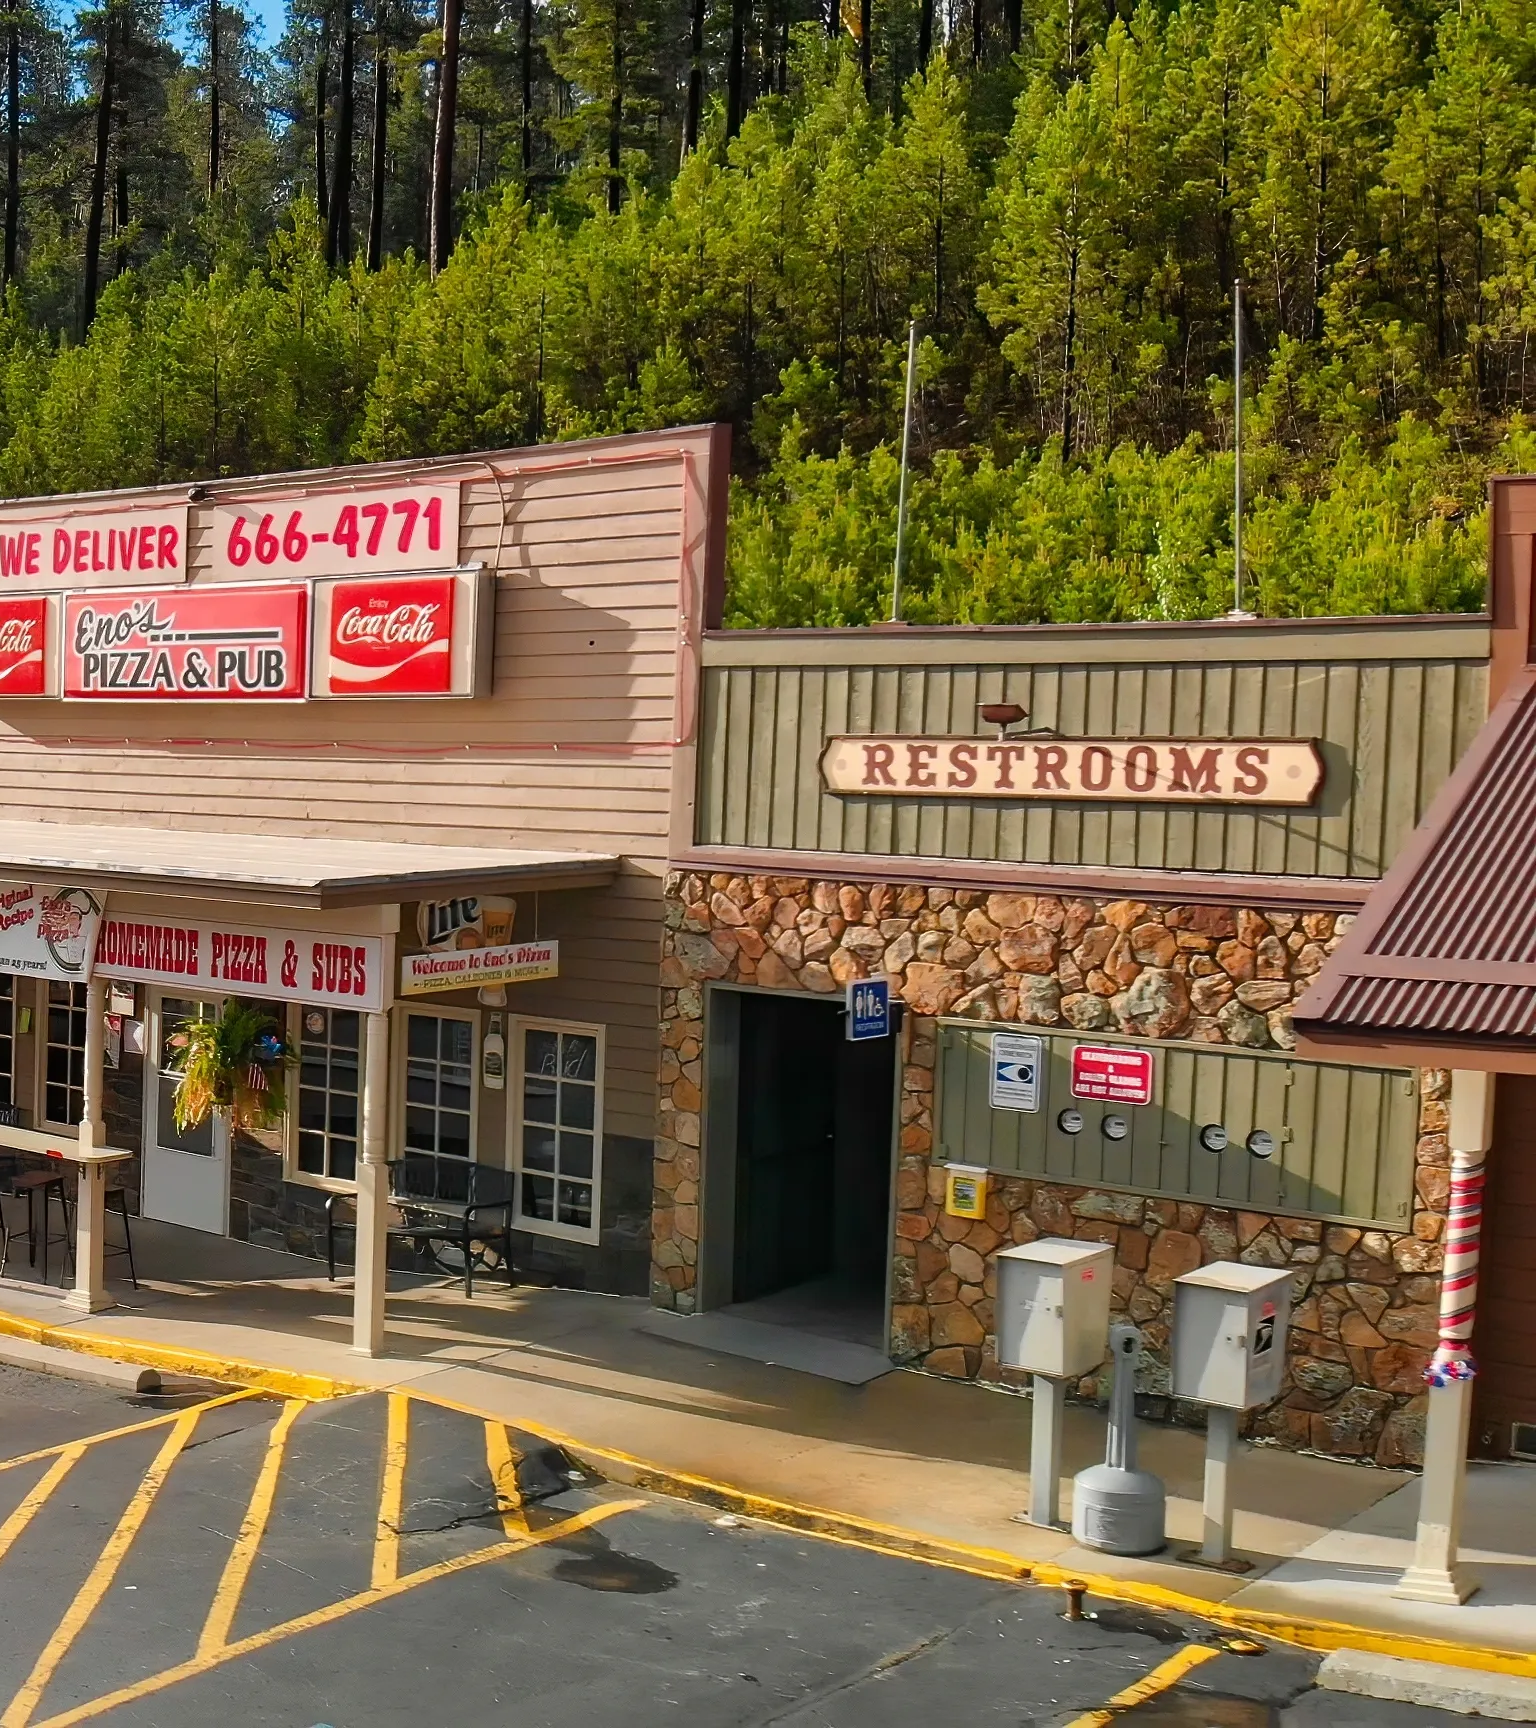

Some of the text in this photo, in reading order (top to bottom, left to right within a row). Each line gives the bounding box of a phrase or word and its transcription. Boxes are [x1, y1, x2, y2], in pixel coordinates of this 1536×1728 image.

[0, 524, 179, 578] WE DELIVER
[227, 497, 443, 568] 666-4771
[75, 599, 175, 655] Eno's
[83, 649, 285, 689] PIZZA & PUB
[861, 743, 1270, 796] RESTROOMS
[11, 959, 21, 969] 25
[21, 960, 48, 971] years!
[95, 919, 366, 996] HOMEMADE PIZZA & SUBS
[412, 947, 552, 976] Welcome to Eno's Pizza
